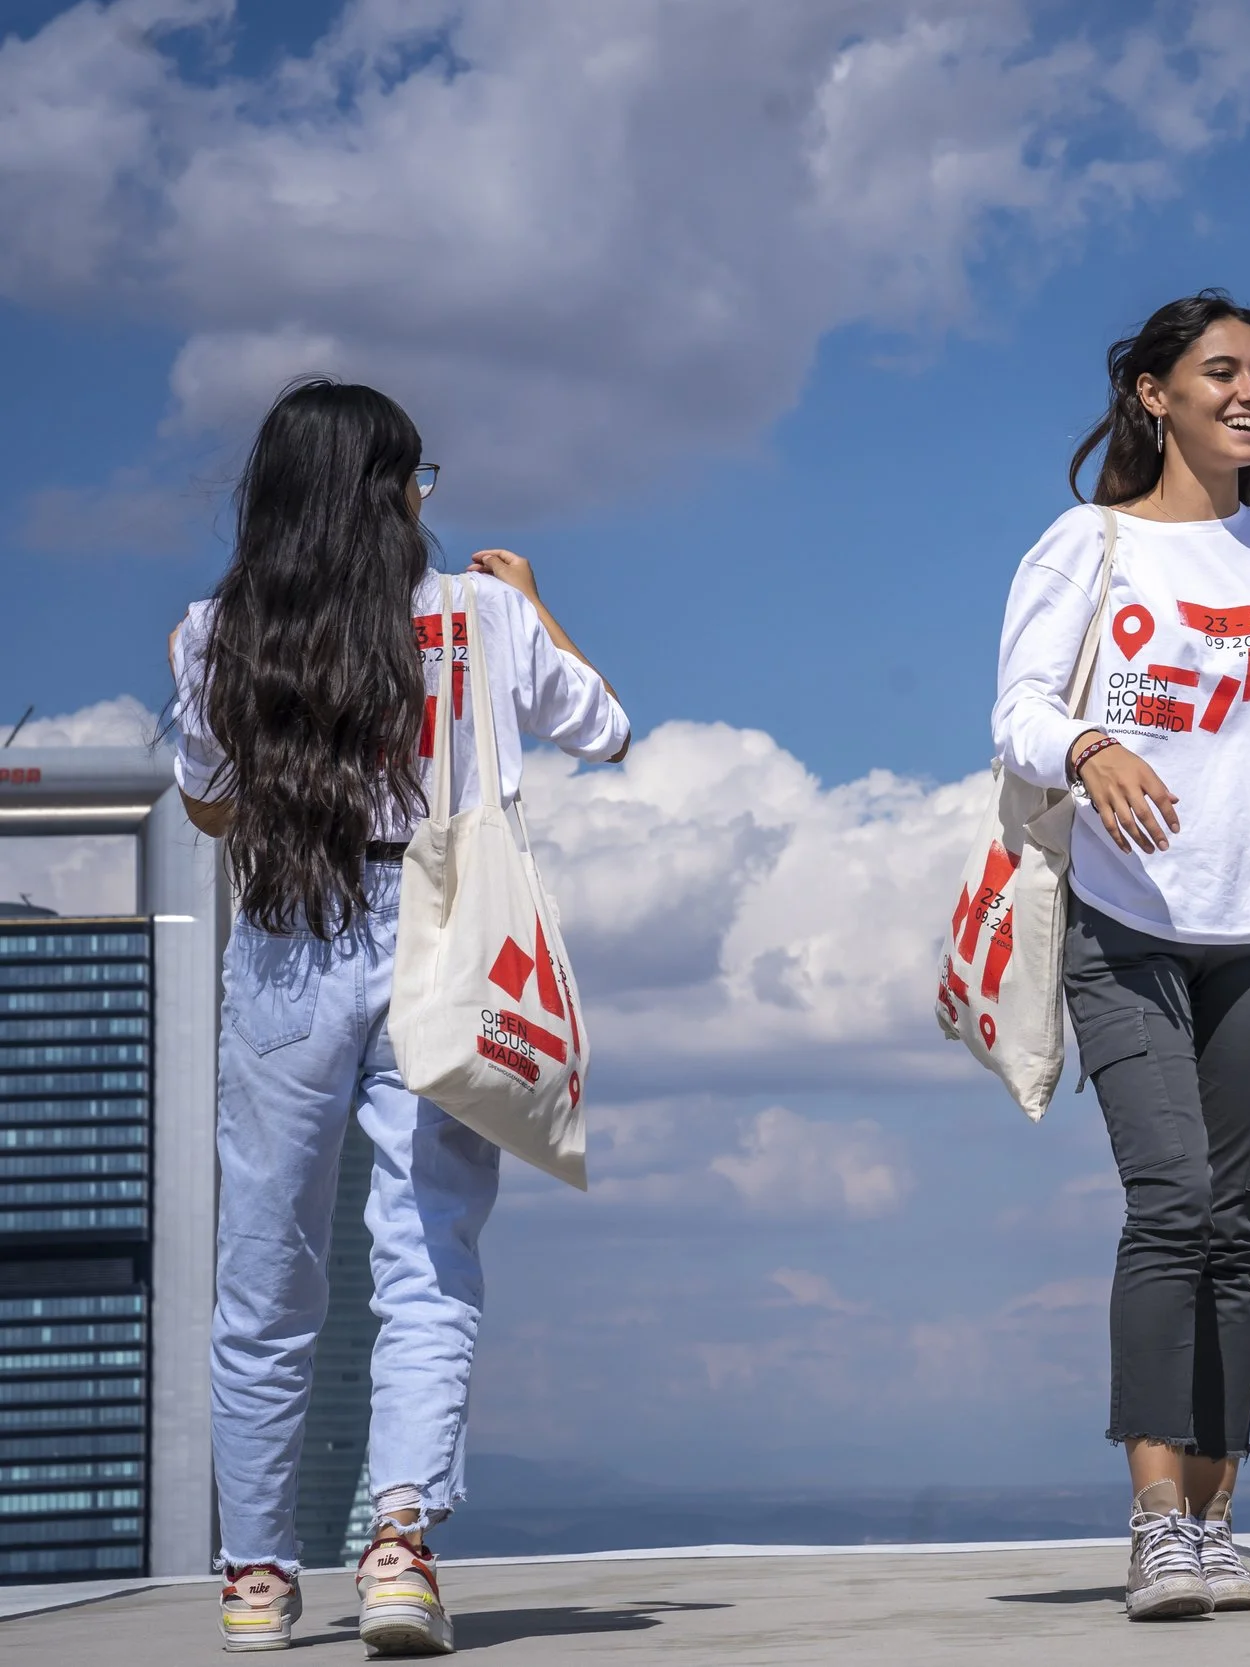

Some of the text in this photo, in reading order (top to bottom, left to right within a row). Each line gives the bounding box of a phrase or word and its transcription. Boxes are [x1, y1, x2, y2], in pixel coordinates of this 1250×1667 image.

[415, 626, 429, 645] 3
[1204, 615, 1228, 633] 23
[1108, 672, 1169, 693] OPEN
[1107, 690, 1177, 713] HOUSE
[1105, 708, 1185, 733] MADRID
[980, 887, 1006, 910] 23
[481, 1009, 528, 1040] OPEN
[483, 1023, 536, 1062] HOUSE
[482, 1040, 541, 1082] MADRID
[377, 1553, 400, 1568] nike
[249, 1582, 271, 1595] nike
